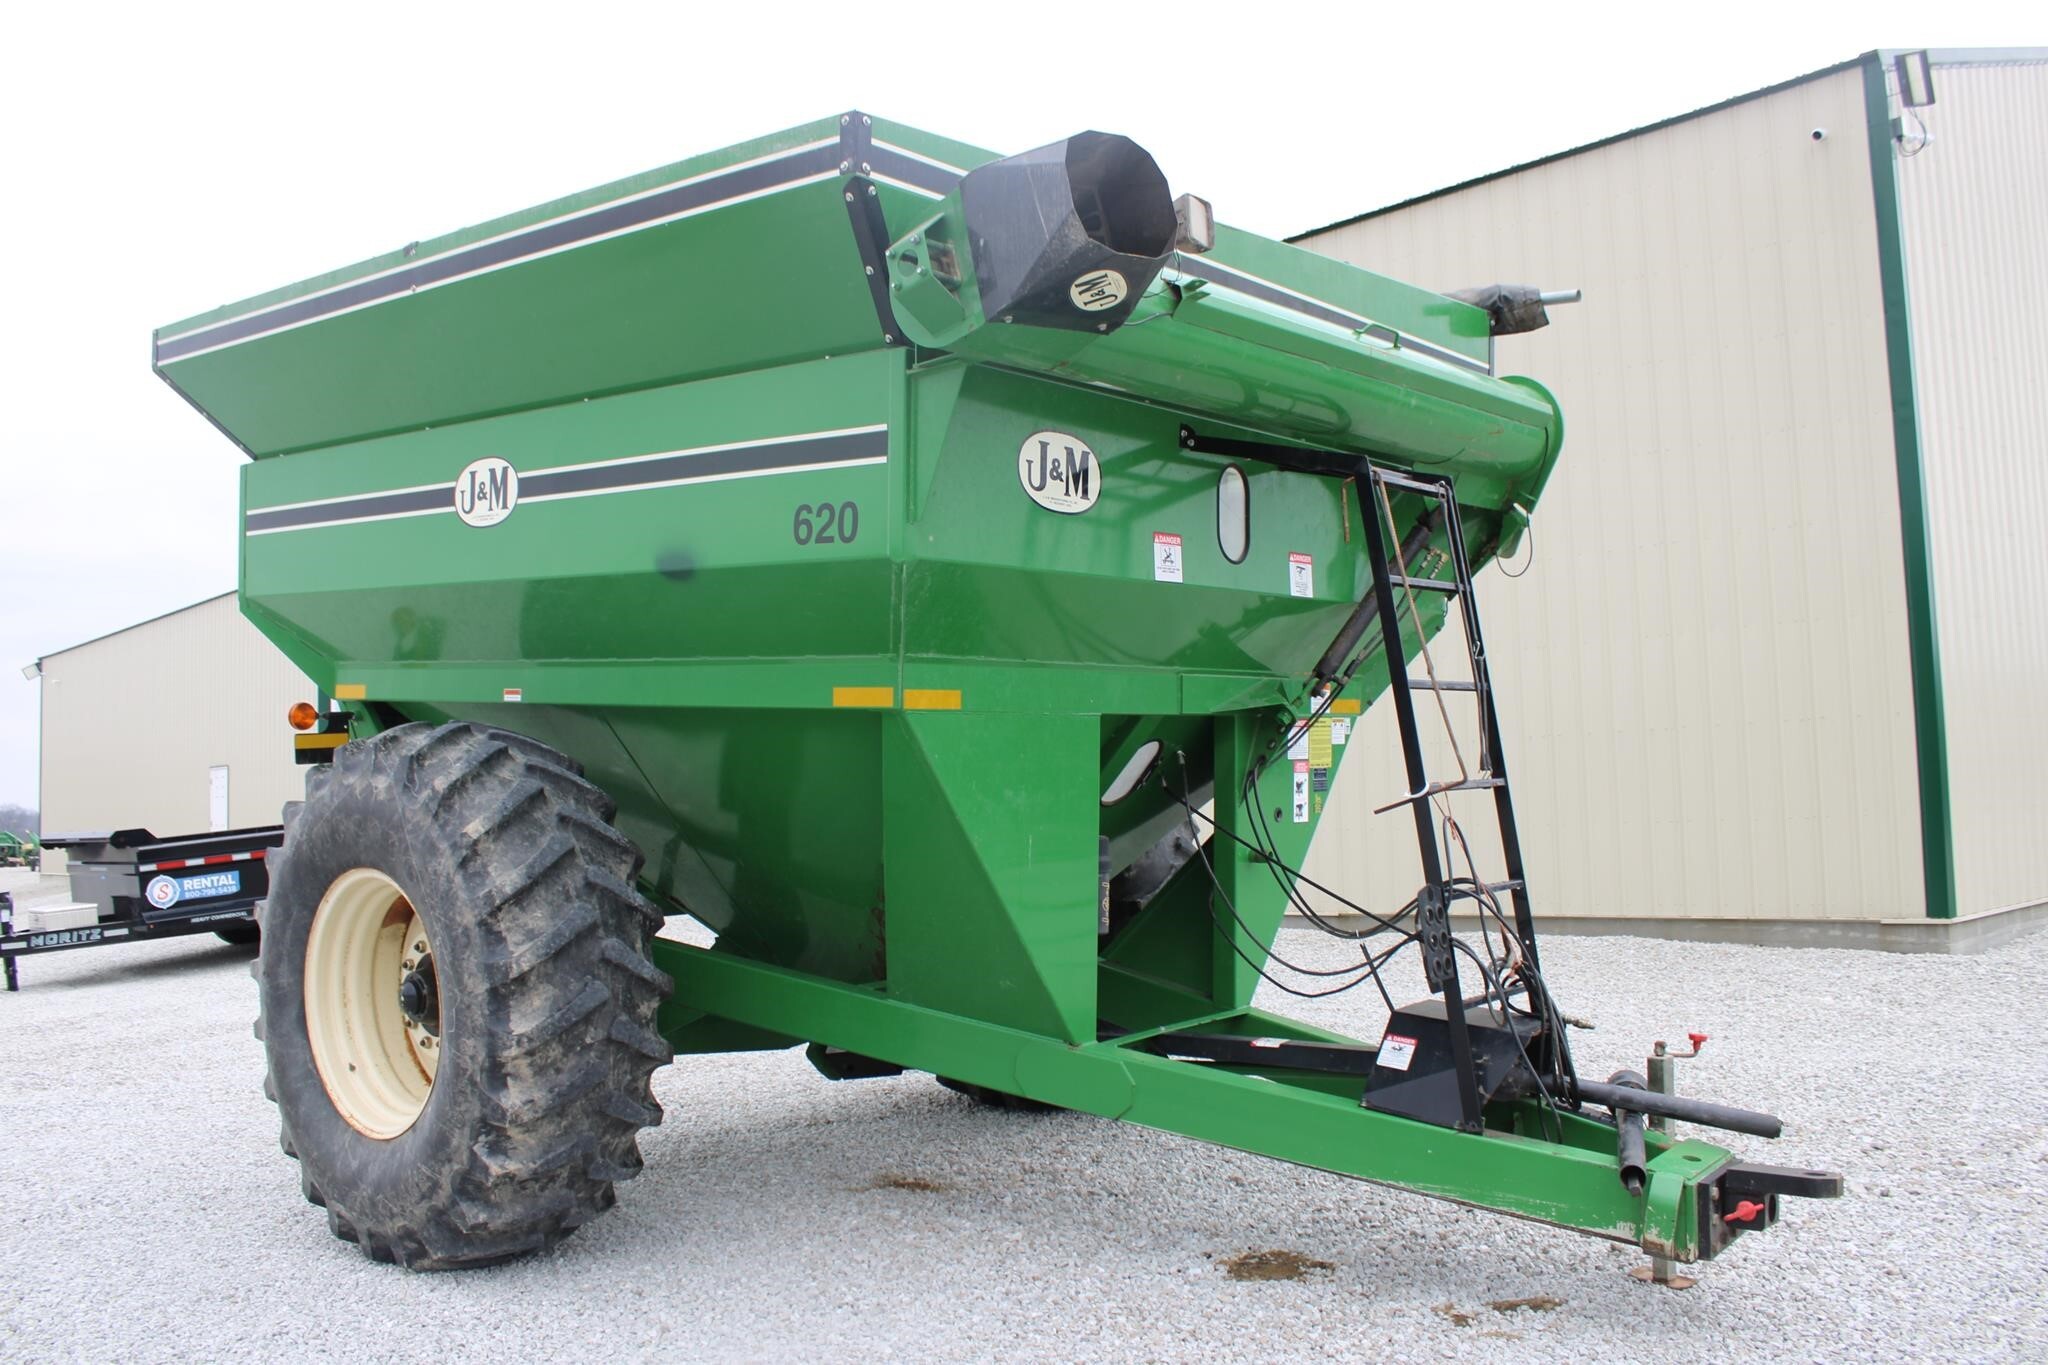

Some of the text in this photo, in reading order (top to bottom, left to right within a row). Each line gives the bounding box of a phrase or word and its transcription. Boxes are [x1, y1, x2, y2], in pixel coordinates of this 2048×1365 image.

[1074, 272, 1118, 308] J&M
[460, 465, 510, 515] J&M
[1025, 440, 1091, 500] J&M
[793, 500, 859, 546] 620
[183, 873, 236, 891] RENTAL
[30, 928, 103, 947] MORITZ
